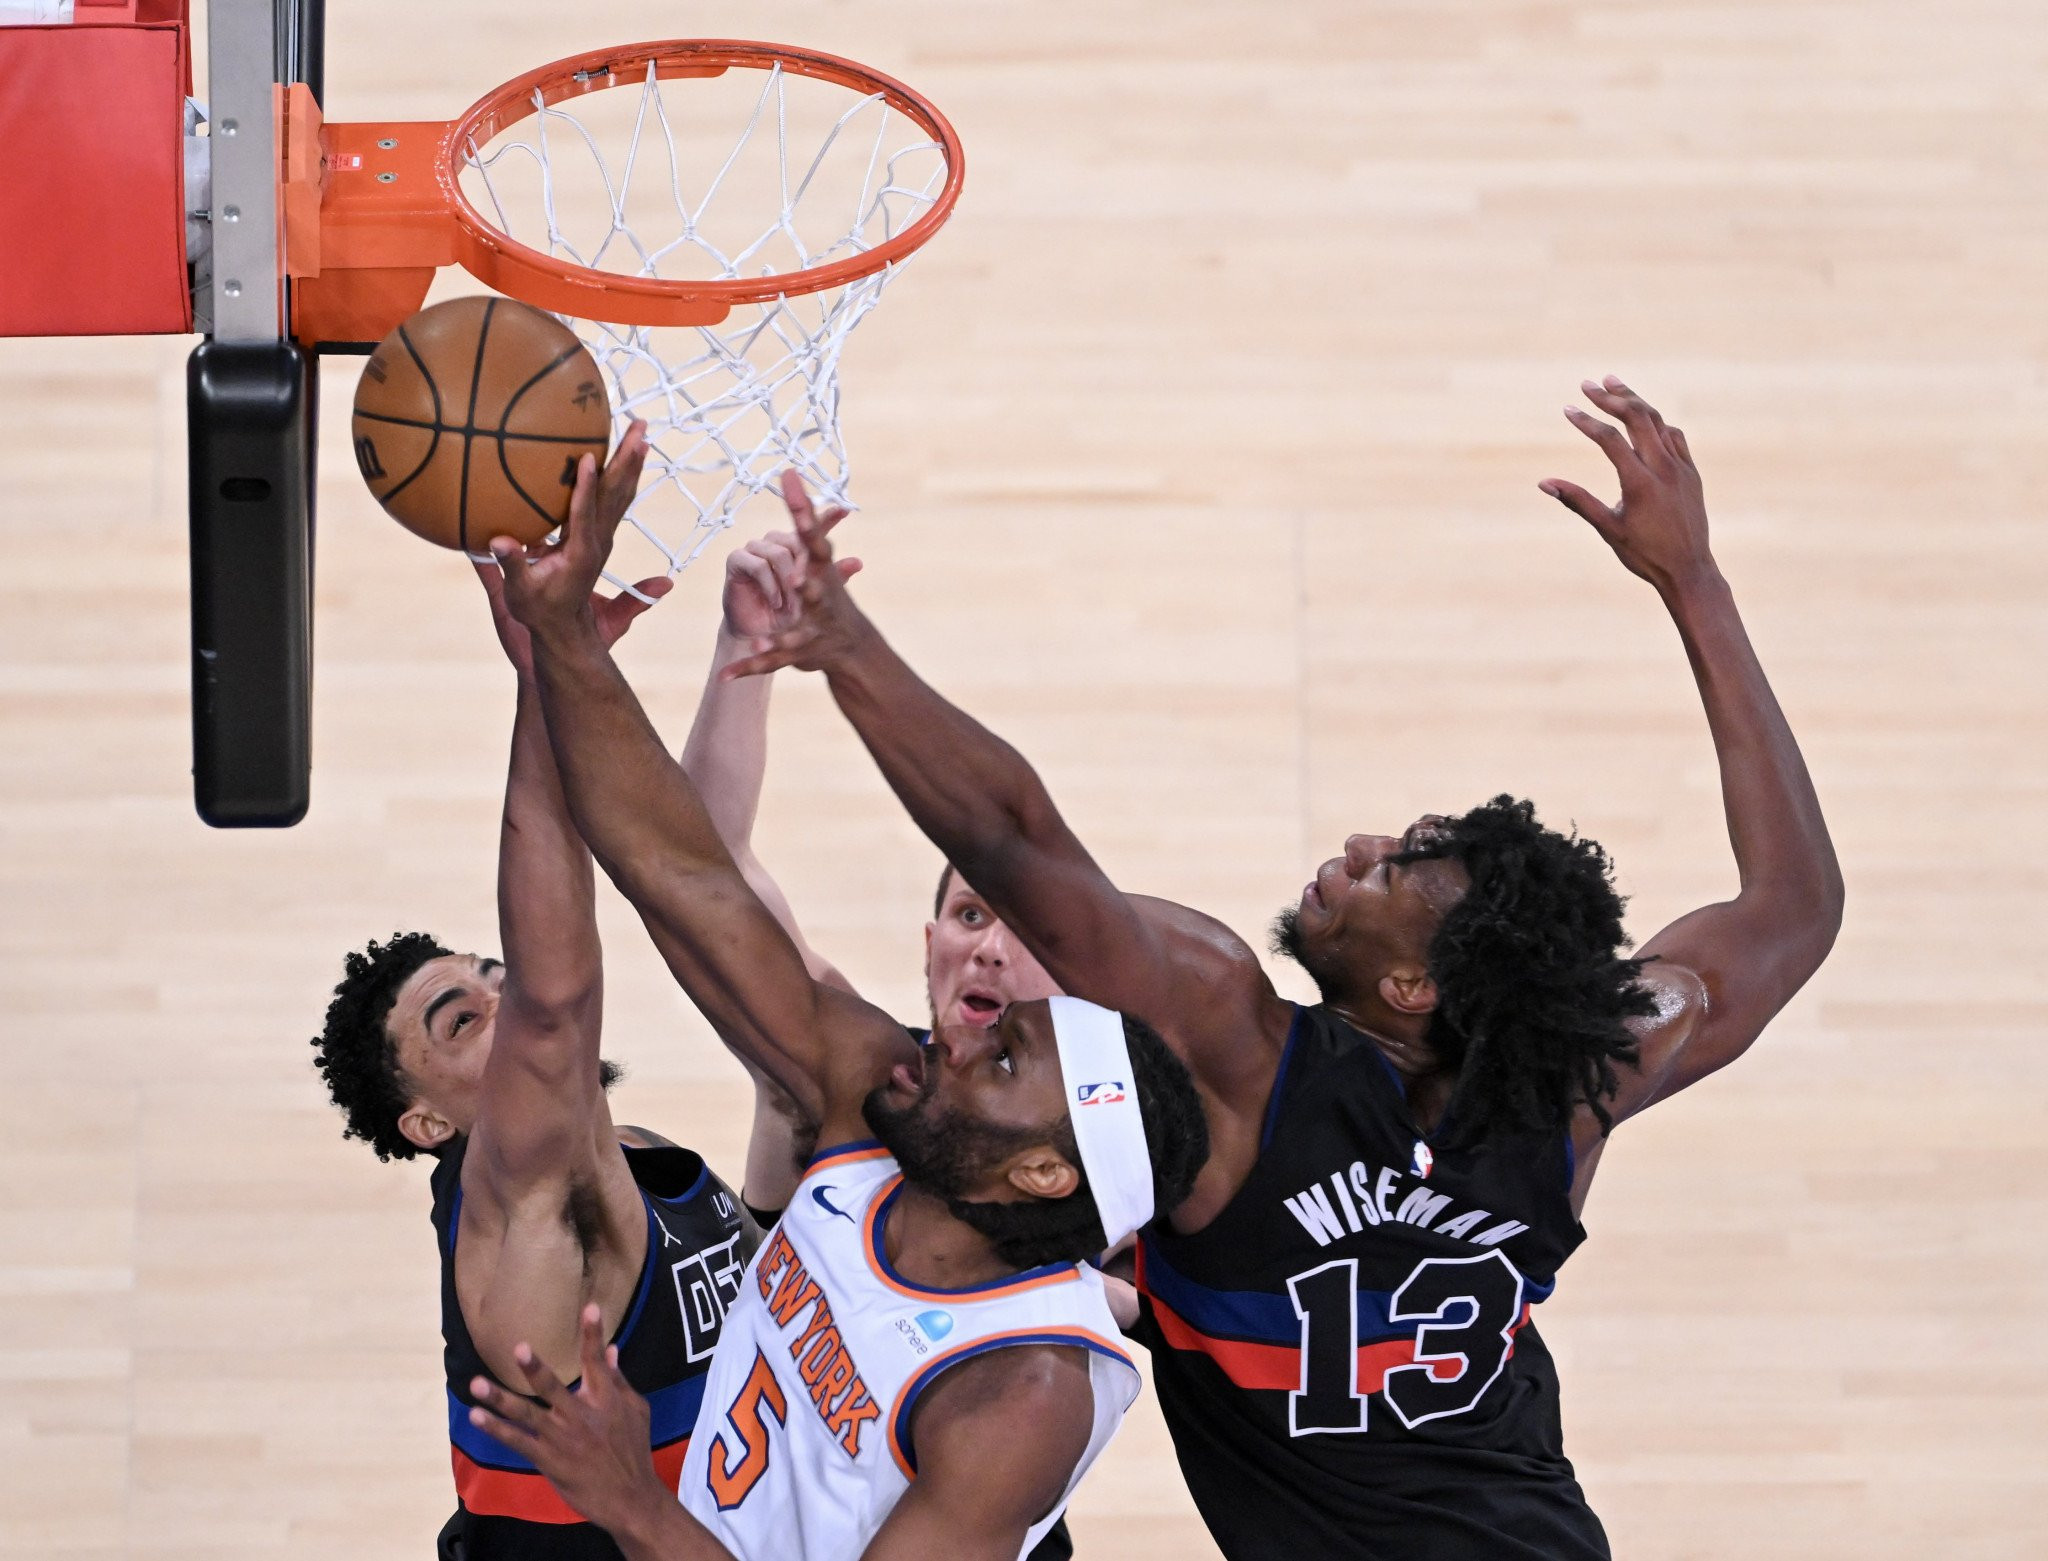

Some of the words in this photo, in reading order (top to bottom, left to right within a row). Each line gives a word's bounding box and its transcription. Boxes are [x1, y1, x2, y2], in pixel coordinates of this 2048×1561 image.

[1283, 1161, 1530, 1246] WISEMAN
[670, 1230, 743, 1364] DE
[894, 1318, 929, 1356] sphere
[1285, 1248, 1523, 1438] 13
[706, 1346, 787, 1512] 5
[789, 1293, 883, 1459] YORK
